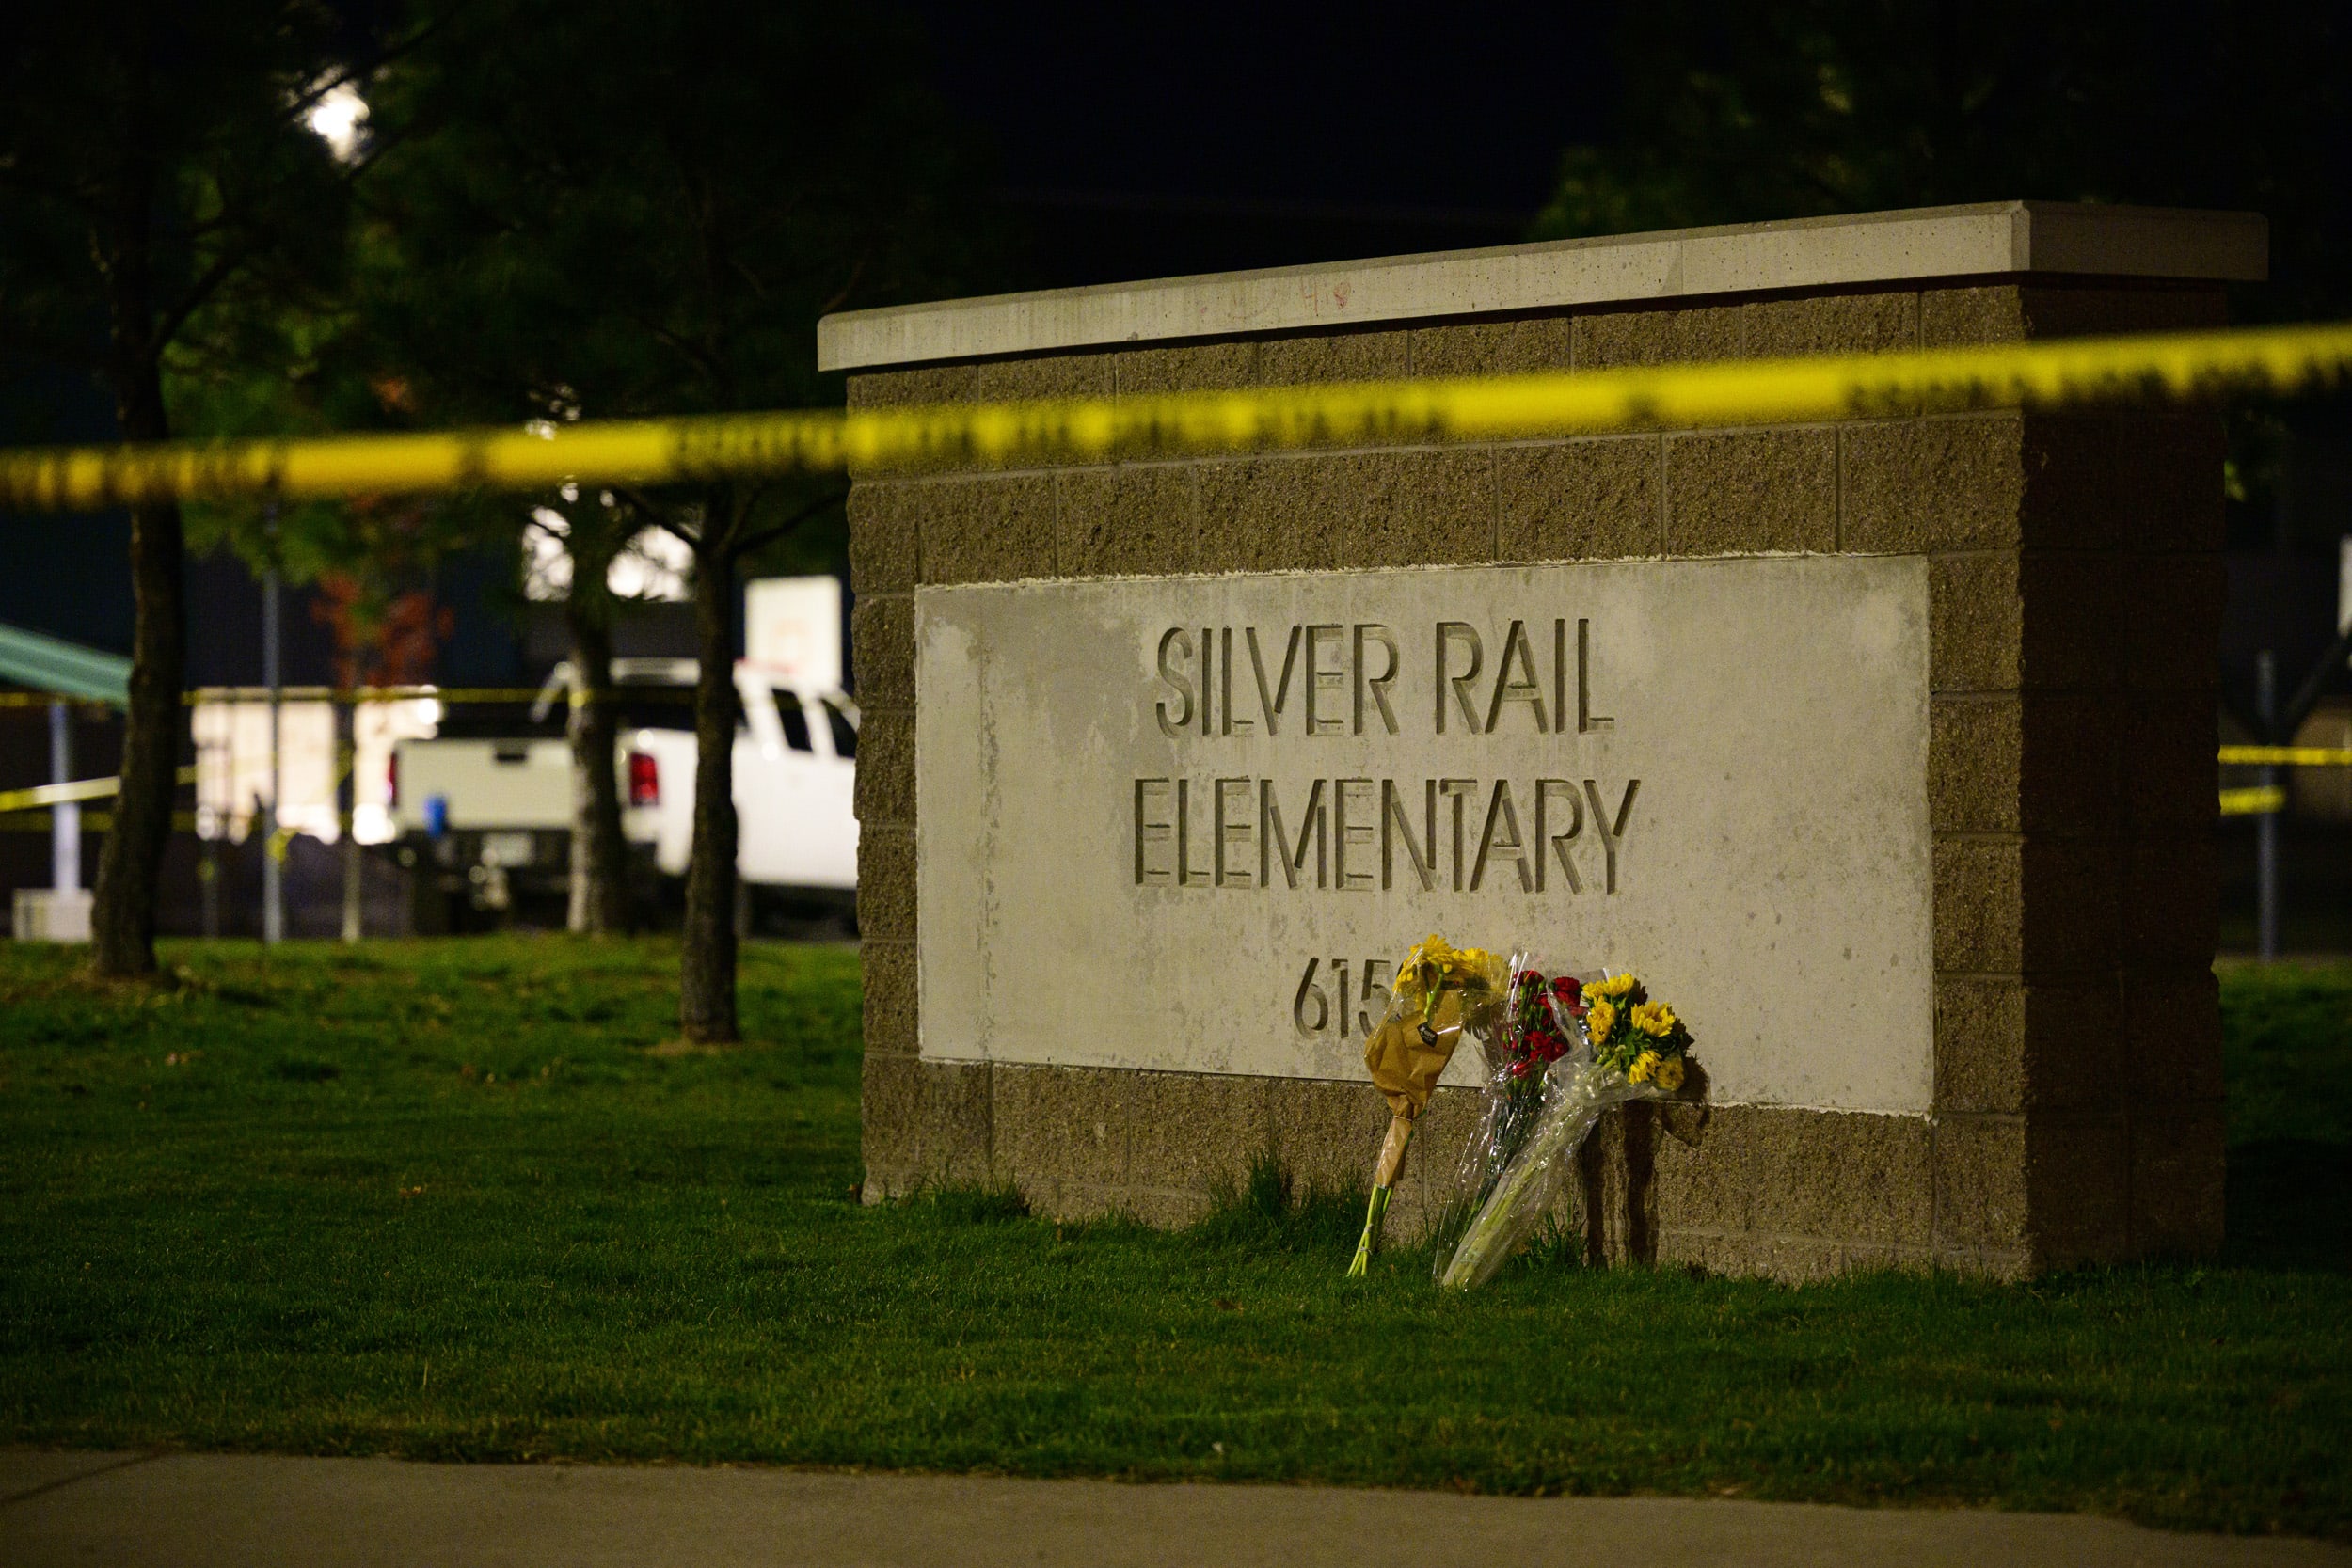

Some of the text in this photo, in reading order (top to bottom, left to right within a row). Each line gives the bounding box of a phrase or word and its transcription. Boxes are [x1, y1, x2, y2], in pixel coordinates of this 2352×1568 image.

[1156, 618, 1615, 737] SILVER RAIL
[1134, 777, 1641, 895] ELEMENTARY
[1294, 958, 1405, 1039] 615
